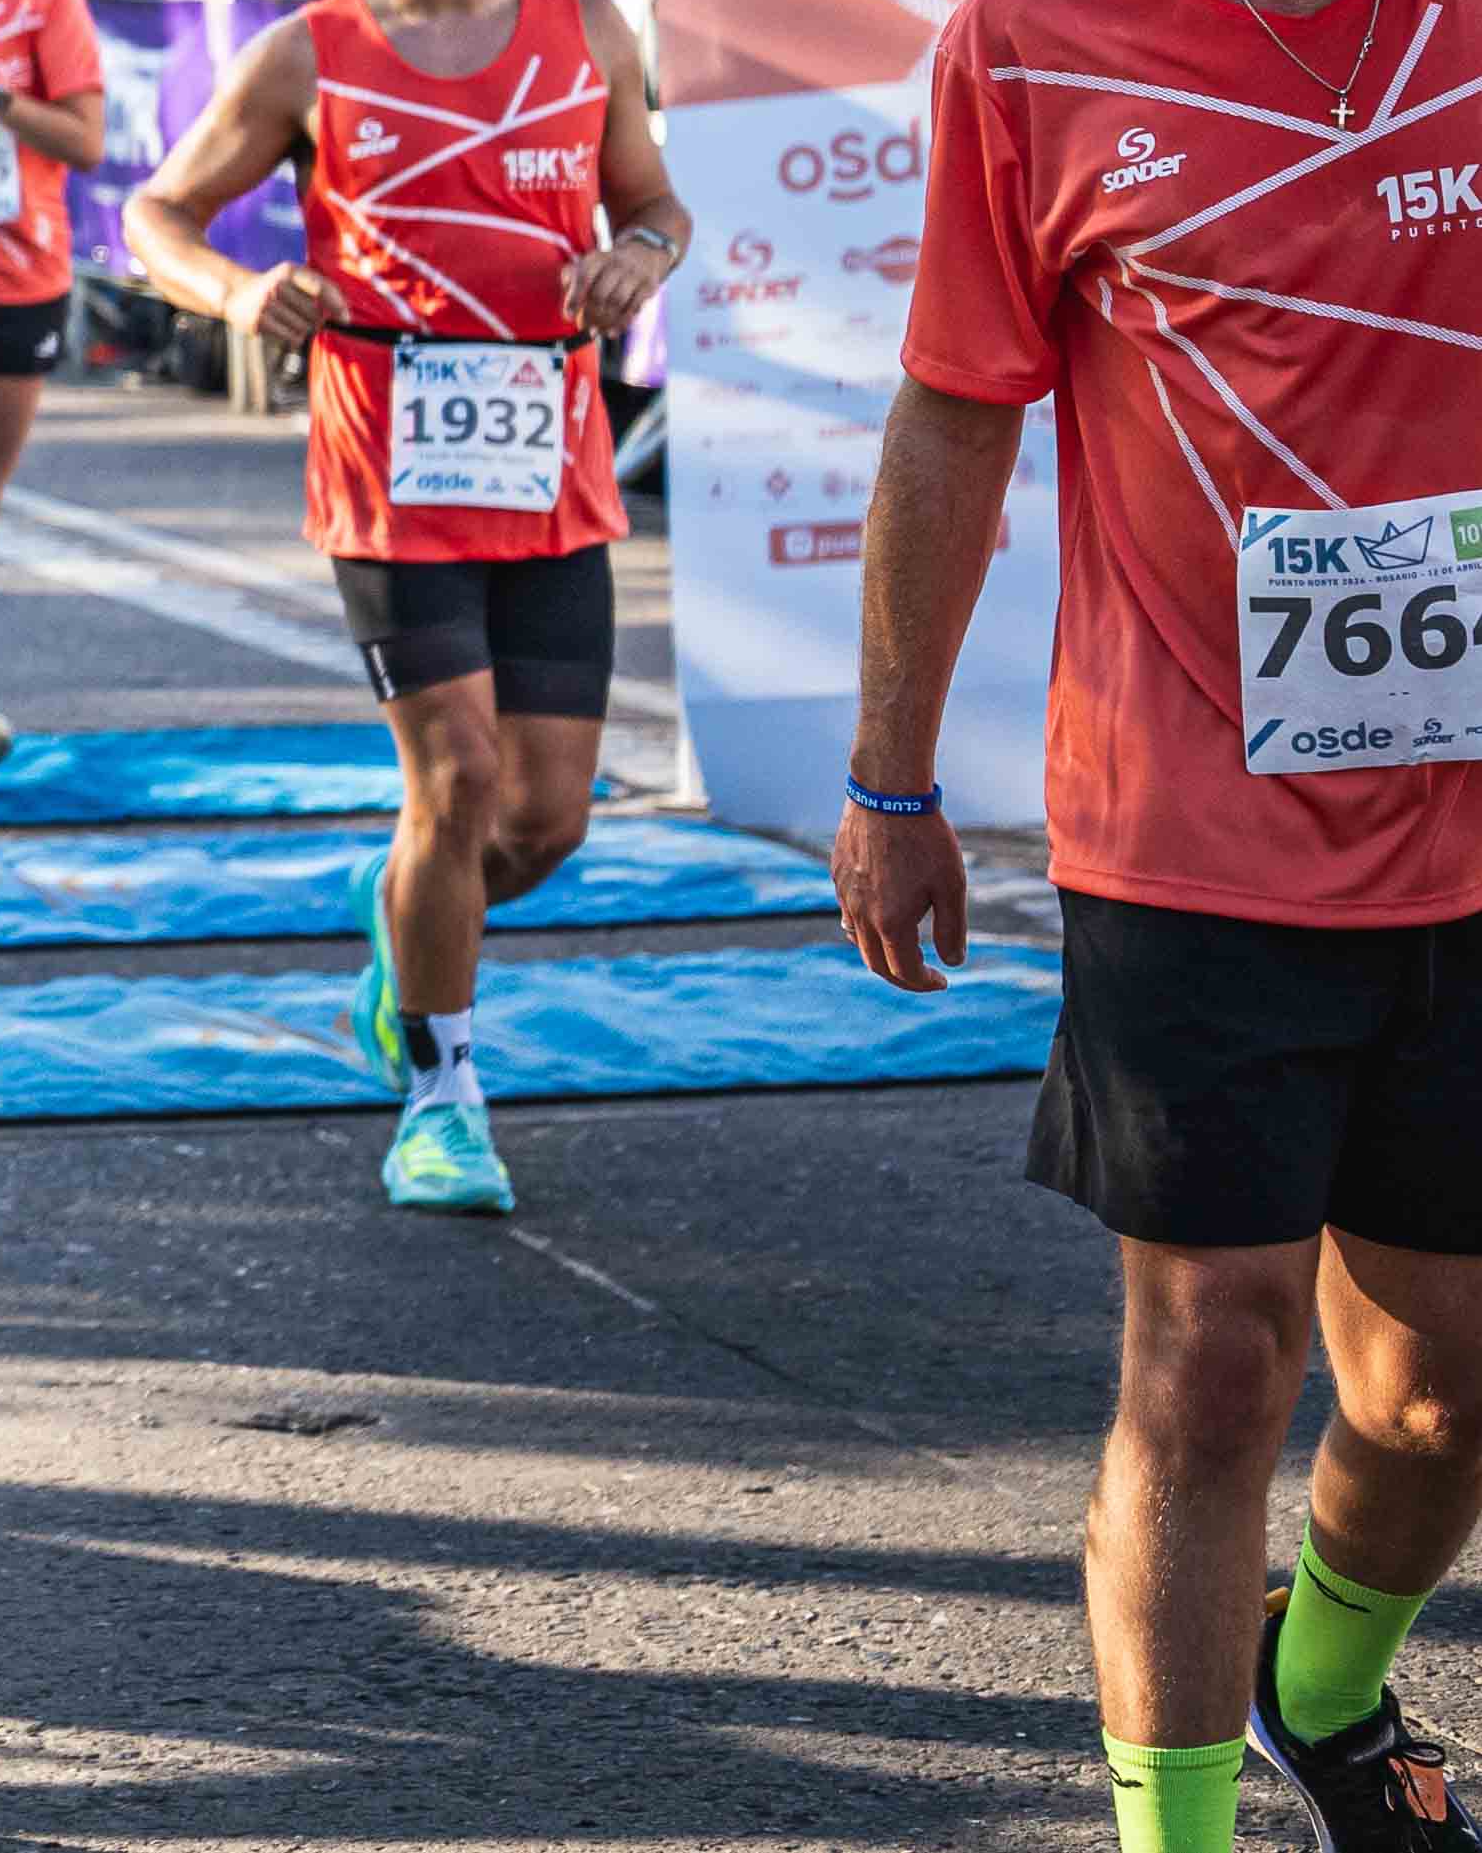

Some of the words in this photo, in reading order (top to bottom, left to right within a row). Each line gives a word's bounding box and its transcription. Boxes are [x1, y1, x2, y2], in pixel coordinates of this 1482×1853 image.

[778, 116, 925, 203] osd
[1376, 163, 1482, 224] 15K
[403, 396, 555, 451] 1932
[1268, 536, 1352, 575] 15K
[1249, 584, 1482, 679] 766
[1290, 721, 1394, 758] osde
